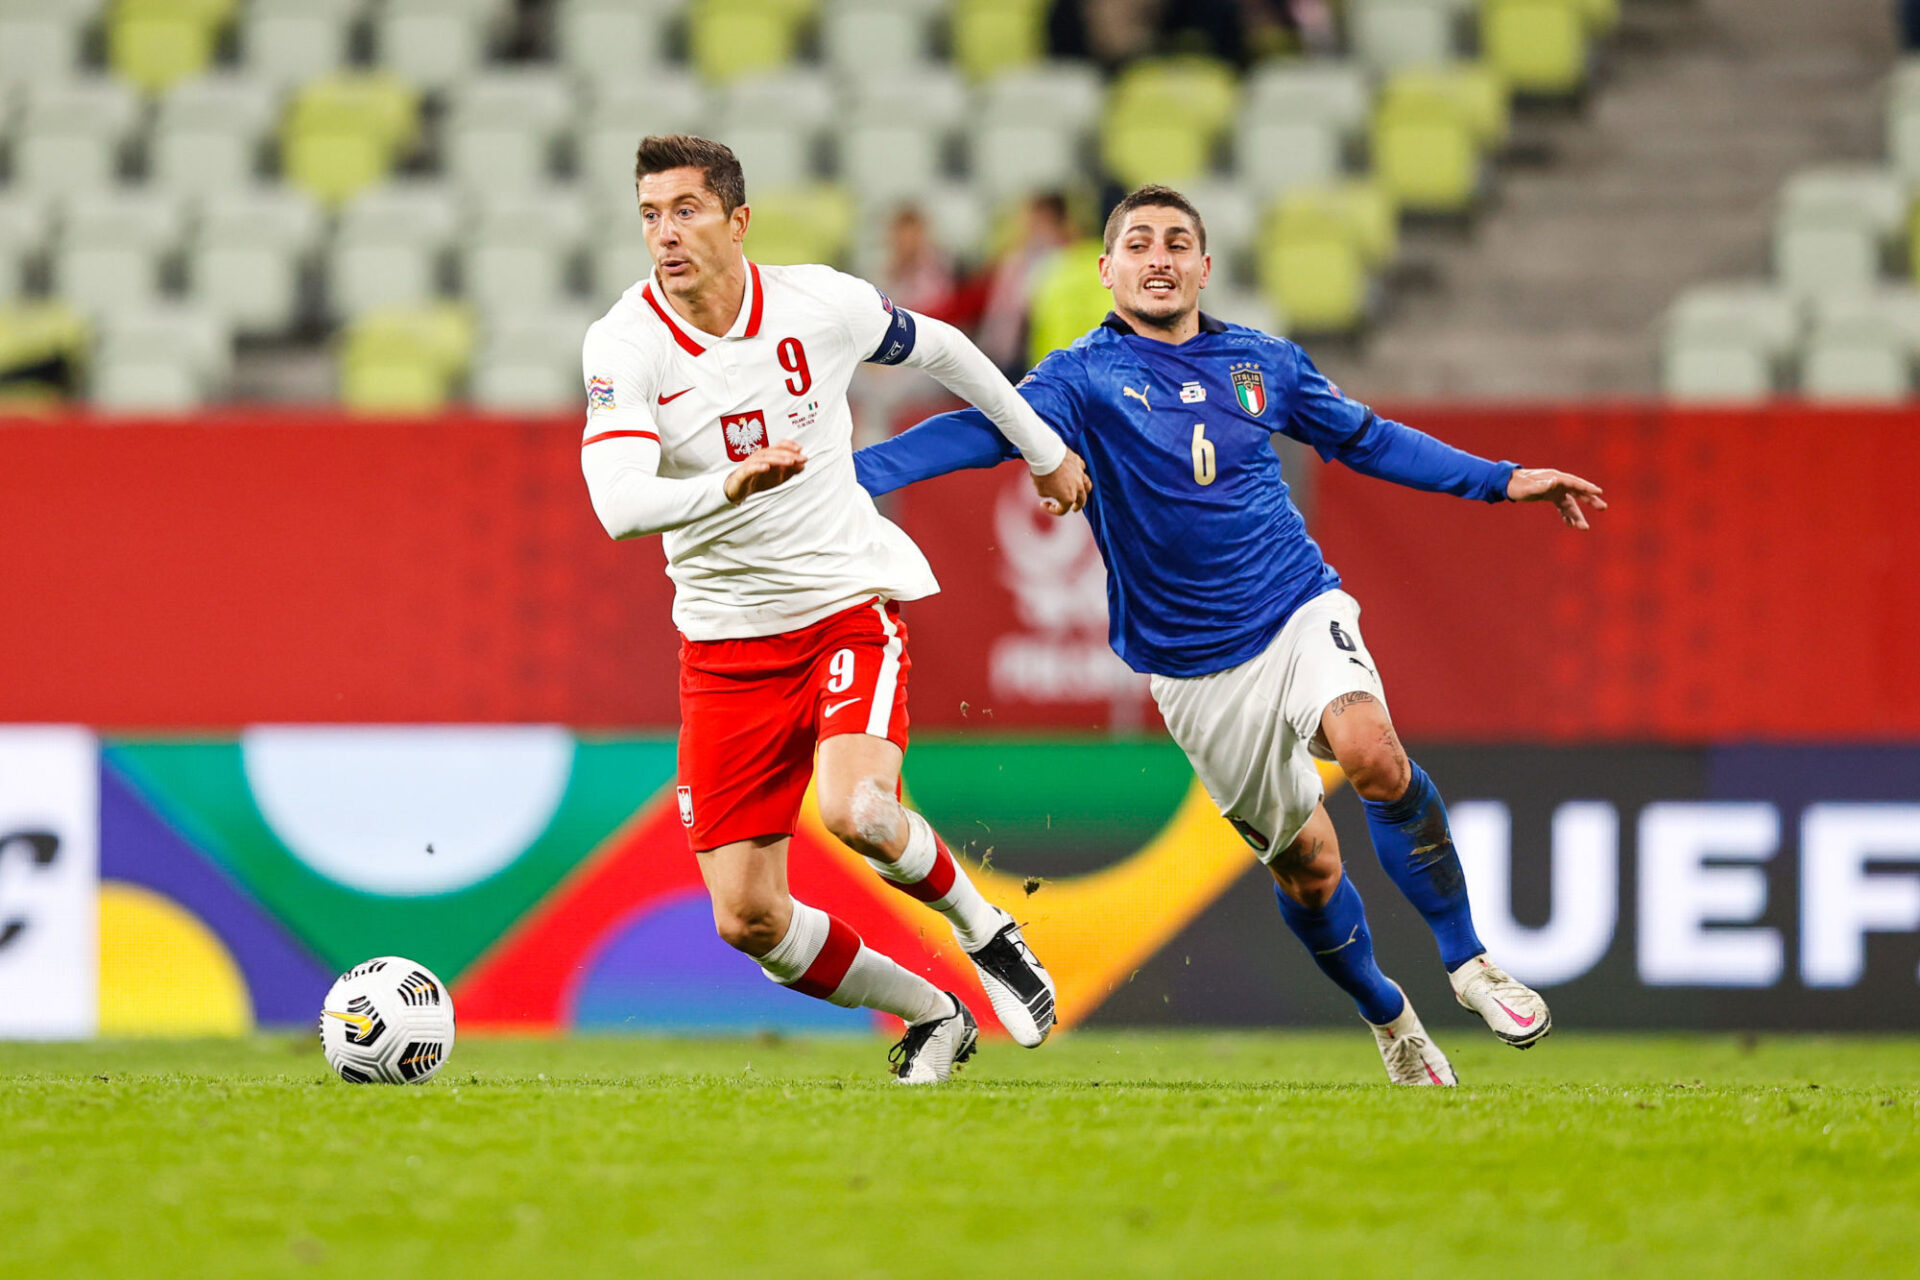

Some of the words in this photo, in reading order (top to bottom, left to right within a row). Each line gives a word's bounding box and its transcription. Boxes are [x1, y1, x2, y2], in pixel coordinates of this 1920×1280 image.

[777, 337, 812, 397] 9
[1234, 373, 1260, 381] ITALIA
[1191, 423, 1216, 486] 6
[1329, 620, 1357, 652] 6
[827, 648, 855, 693] 9
[1450, 800, 1920, 988] UEF
